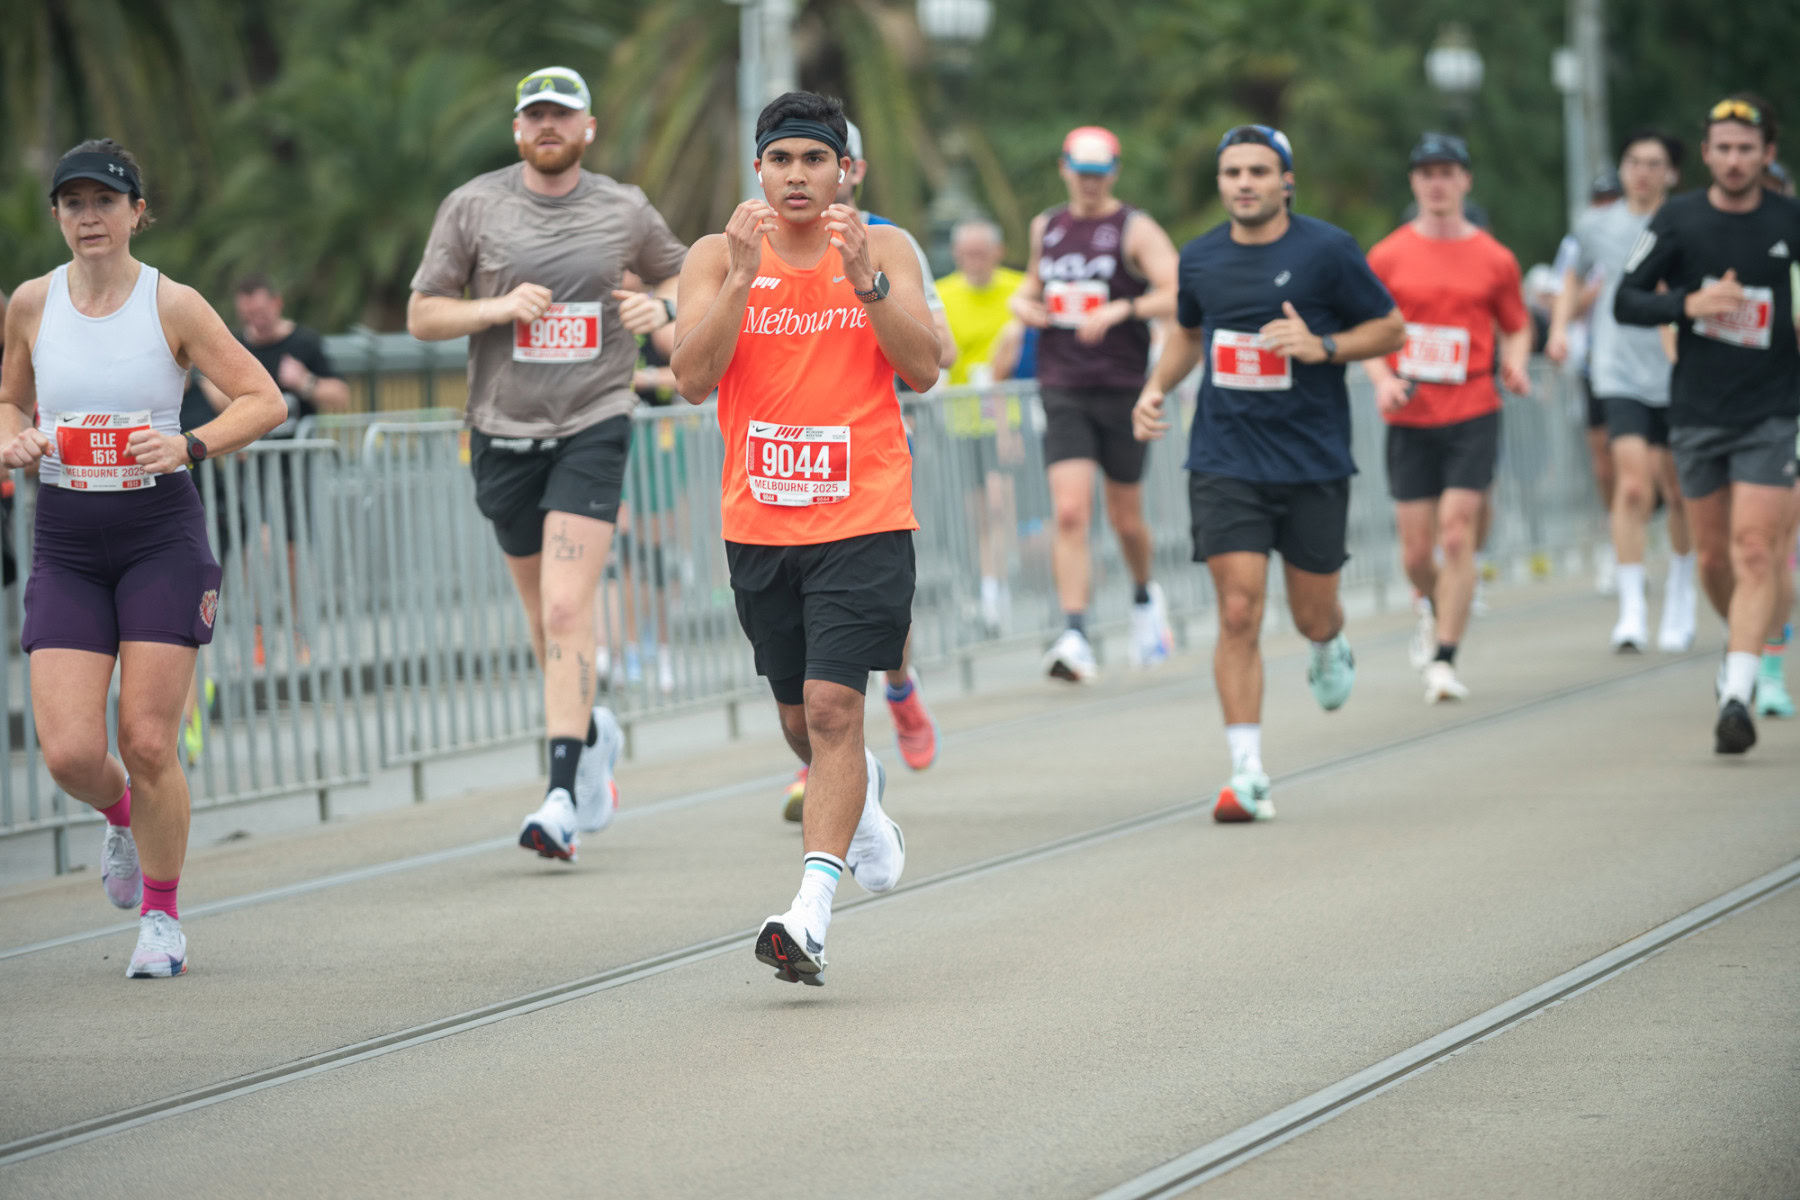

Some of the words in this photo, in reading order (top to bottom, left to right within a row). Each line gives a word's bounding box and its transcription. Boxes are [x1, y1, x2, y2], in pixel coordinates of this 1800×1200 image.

[743, 306, 867, 335] Melbourne
[530, 318, 587, 347] 9039
[90, 432, 117, 448] ELLE
[91, 449, 118, 465] 1513
[762, 441, 832, 479] 9044
[65, 467, 119, 478] MELBOURNE
[121, 466, 145, 477] 2025
[754, 479, 809, 492] MELBOURNE
[812, 483, 839, 493] 2025
